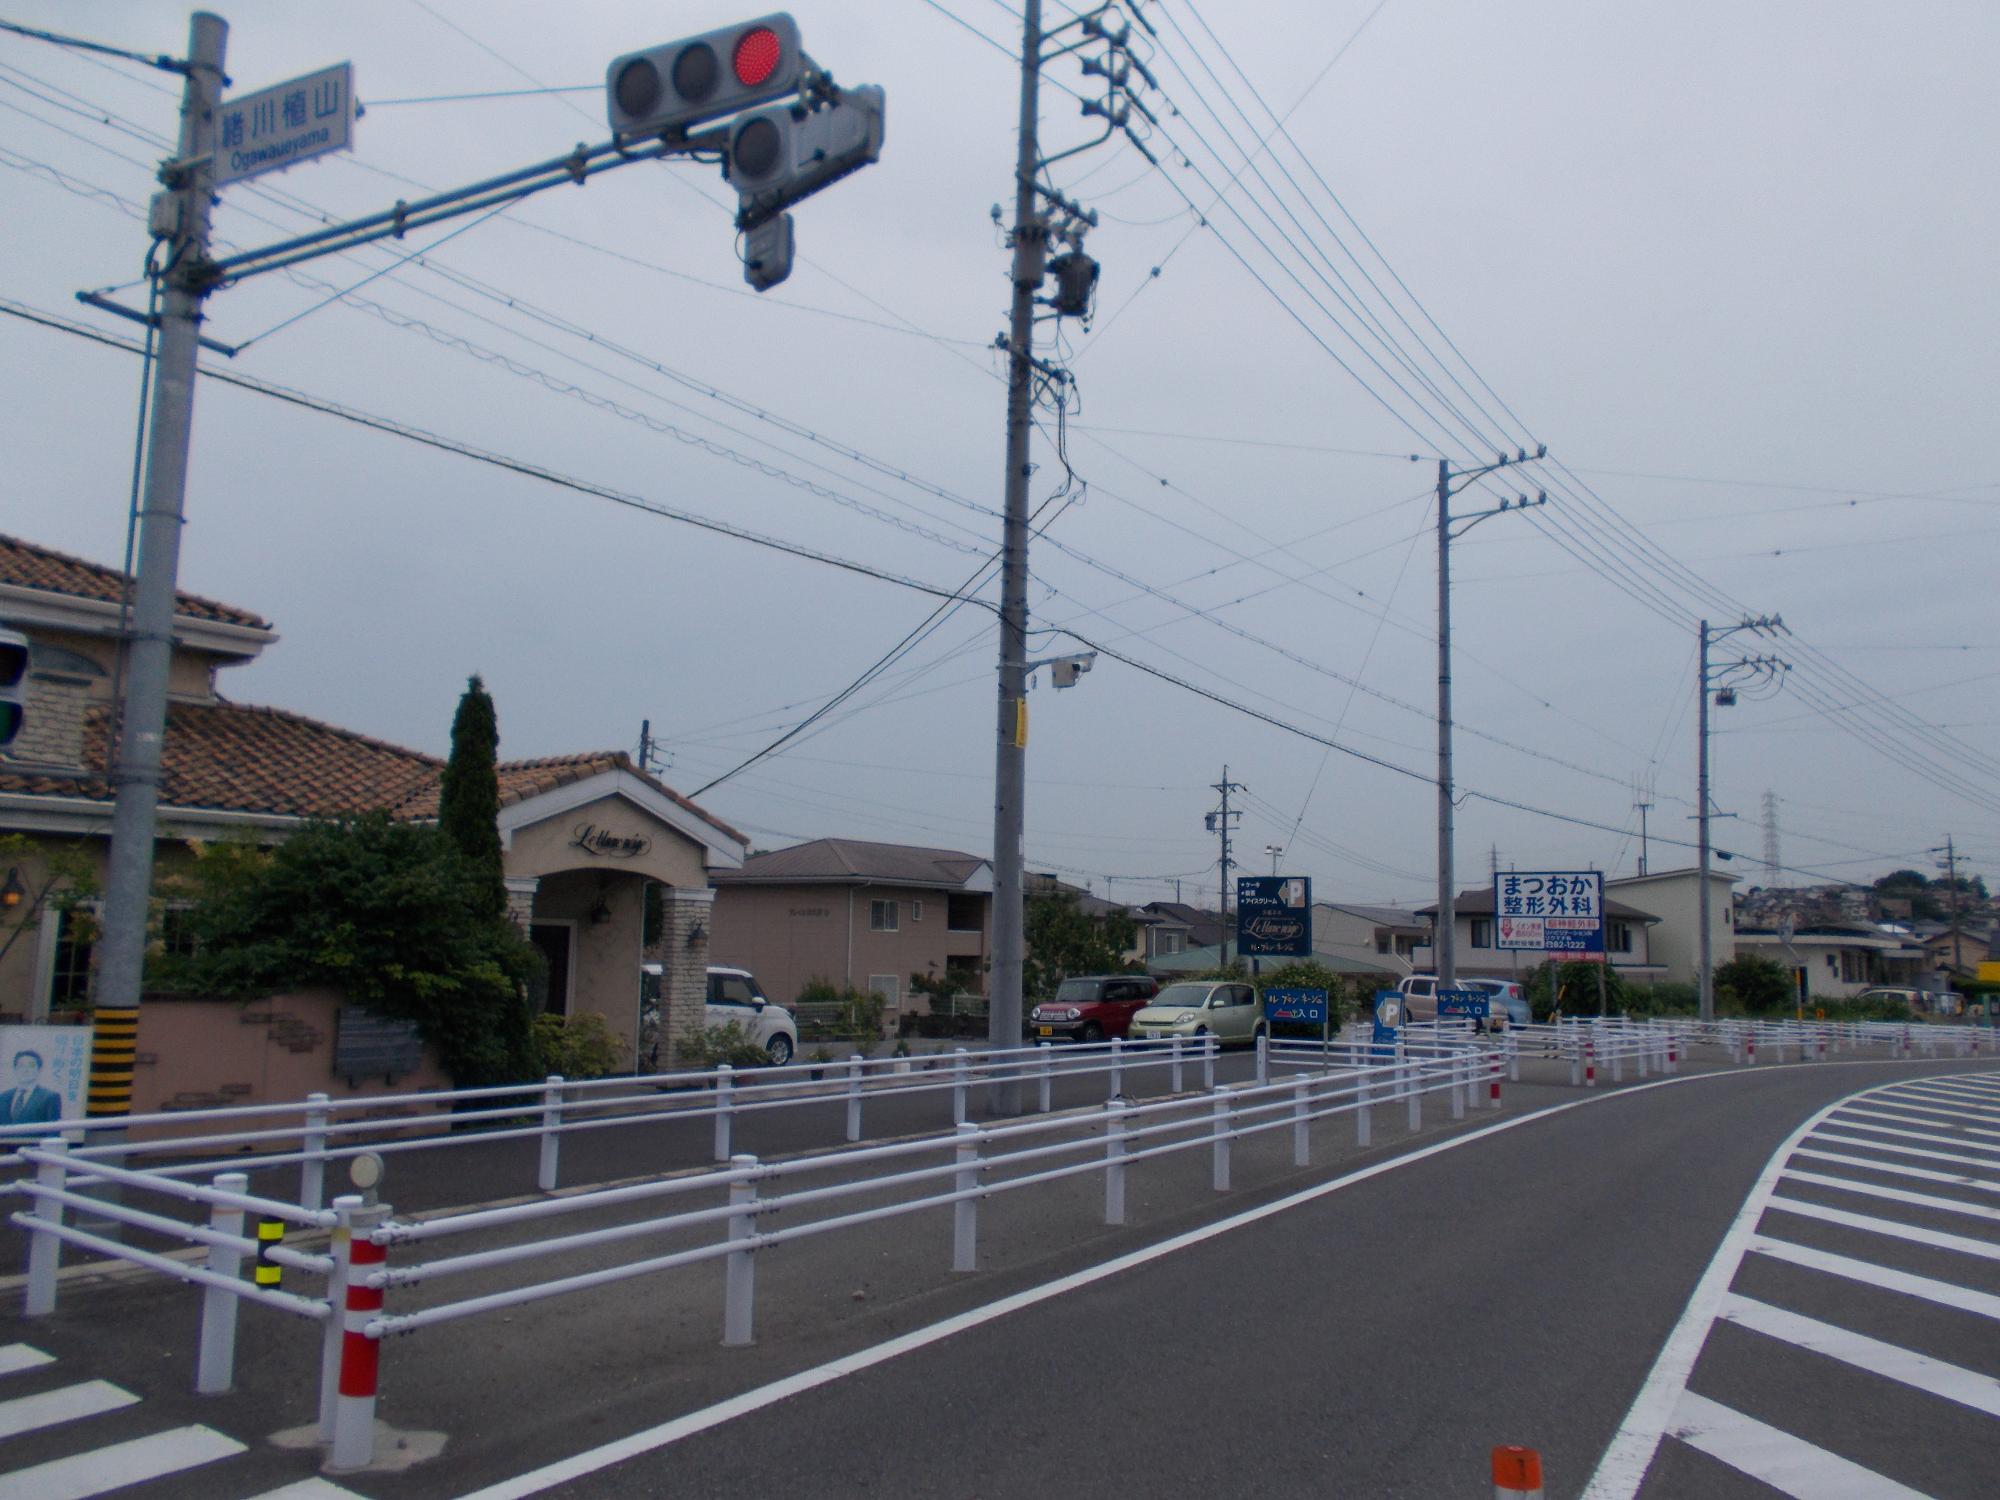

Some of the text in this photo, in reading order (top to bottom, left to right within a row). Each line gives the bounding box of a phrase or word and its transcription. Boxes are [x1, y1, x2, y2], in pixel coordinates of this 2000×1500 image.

[231, 127, 329, 171] Ogawaueyama
[1504, 876, 1593, 895] まつおか
[1504, 896, 1592, 915] 整形外科
[1298, 1008, 1318, 1018] 入口
[1385, 1003, 1398, 1022] P
[1465, 1006, 1482, 1015] 入口
